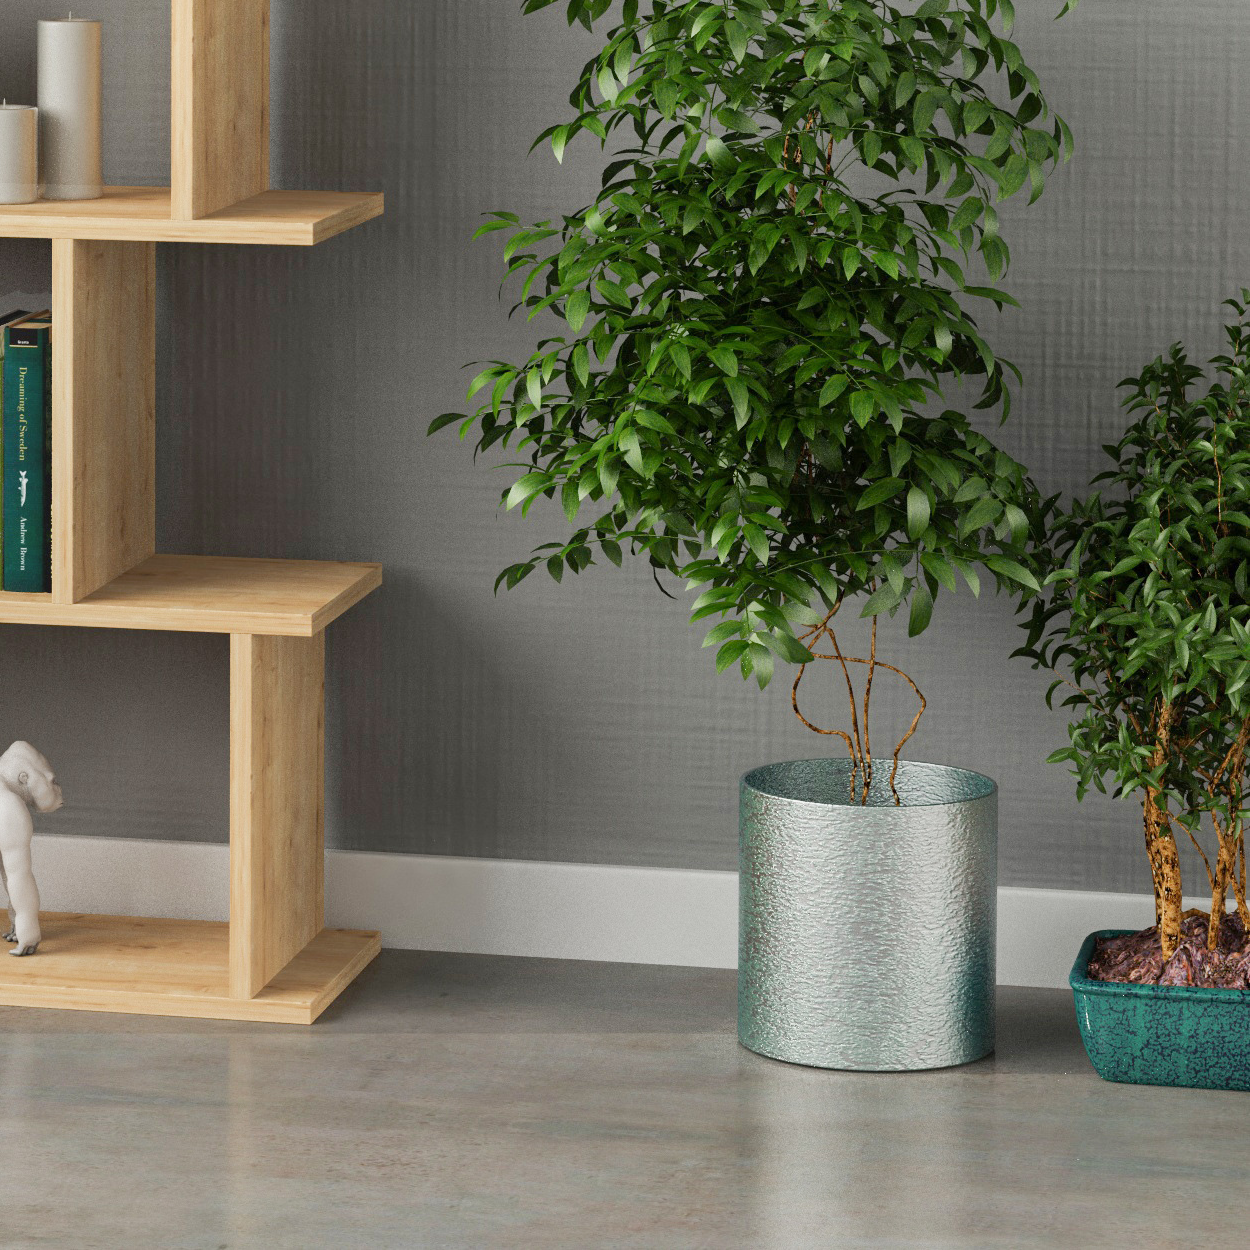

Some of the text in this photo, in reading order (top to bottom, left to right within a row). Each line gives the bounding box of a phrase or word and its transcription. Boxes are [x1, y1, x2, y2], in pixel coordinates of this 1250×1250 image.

[16, 367, 28, 461] Dreaming of Sweden
[20, 516, 28, 571] Andrew Brown
